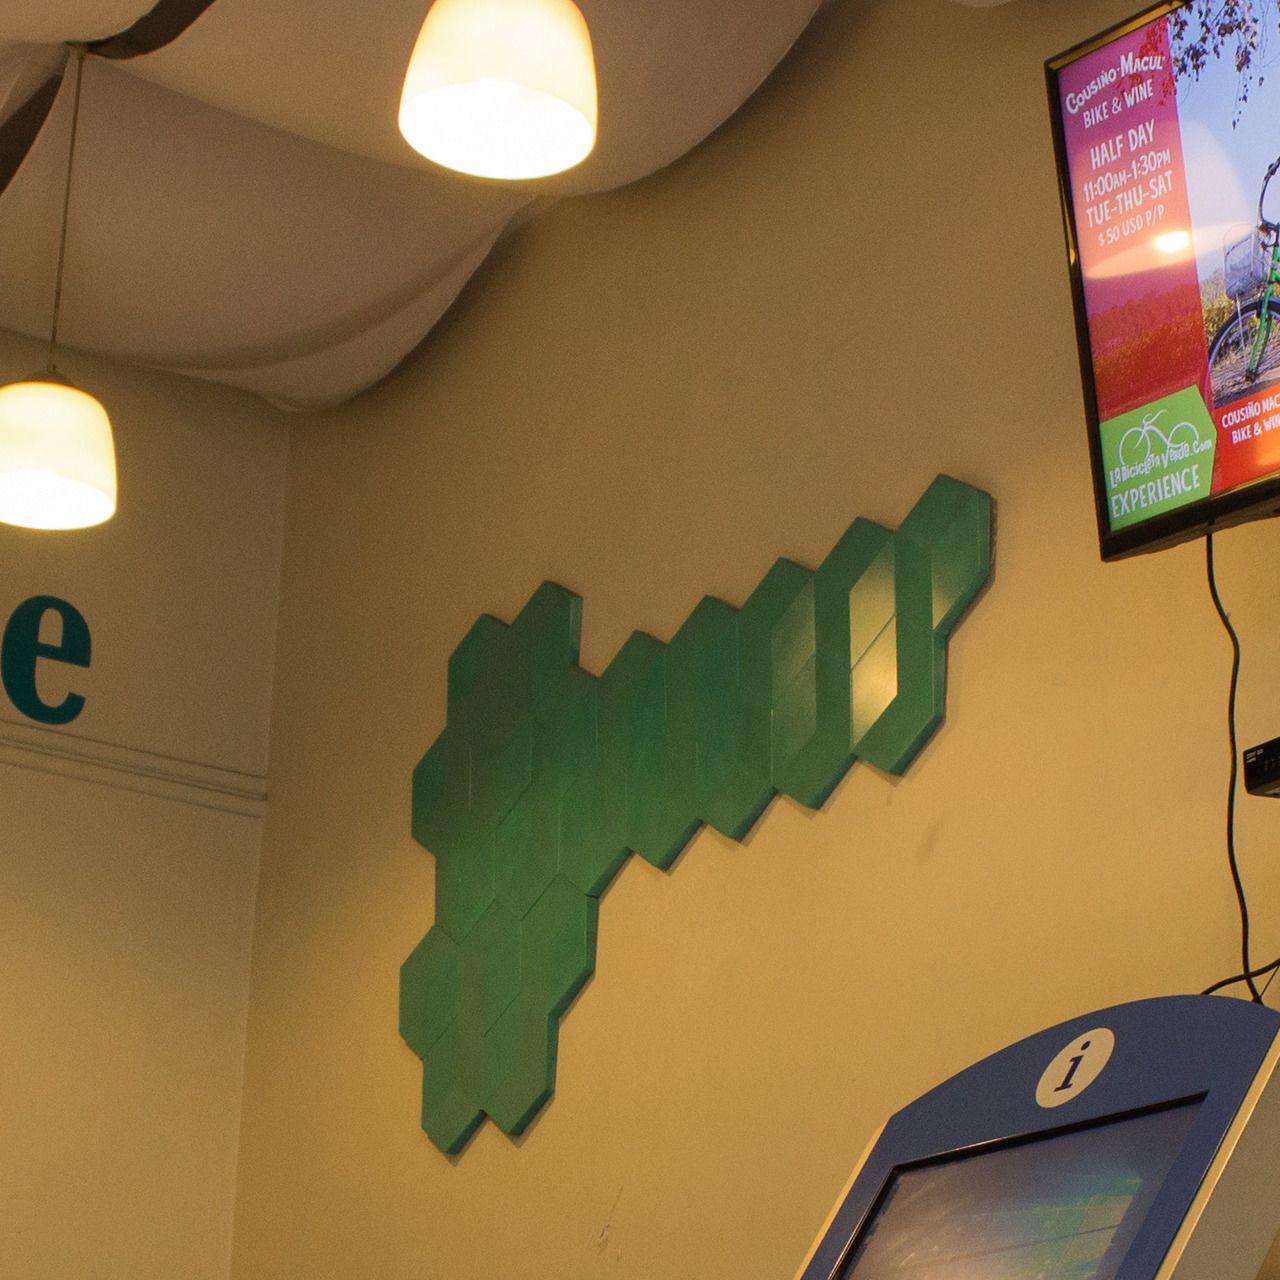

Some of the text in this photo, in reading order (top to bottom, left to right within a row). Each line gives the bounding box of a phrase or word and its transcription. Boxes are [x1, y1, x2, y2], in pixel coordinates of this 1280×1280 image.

[1083, 79, 1153, 128] BIKE & WINE
[1090, 118, 1154, 170] HALF DAY
[1106, 225, 1120, 245] 50
[1122, 215, 1143, 236] USD
[1145, 204, 1165, 226] P/P
[1221, 401, 1261, 428] COUSIÑO
[1232, 426, 1252, 445] BIKE
[1253, 423, 1262, 436] &
[1110, 464, 1201, 518] EXPERIENCE
